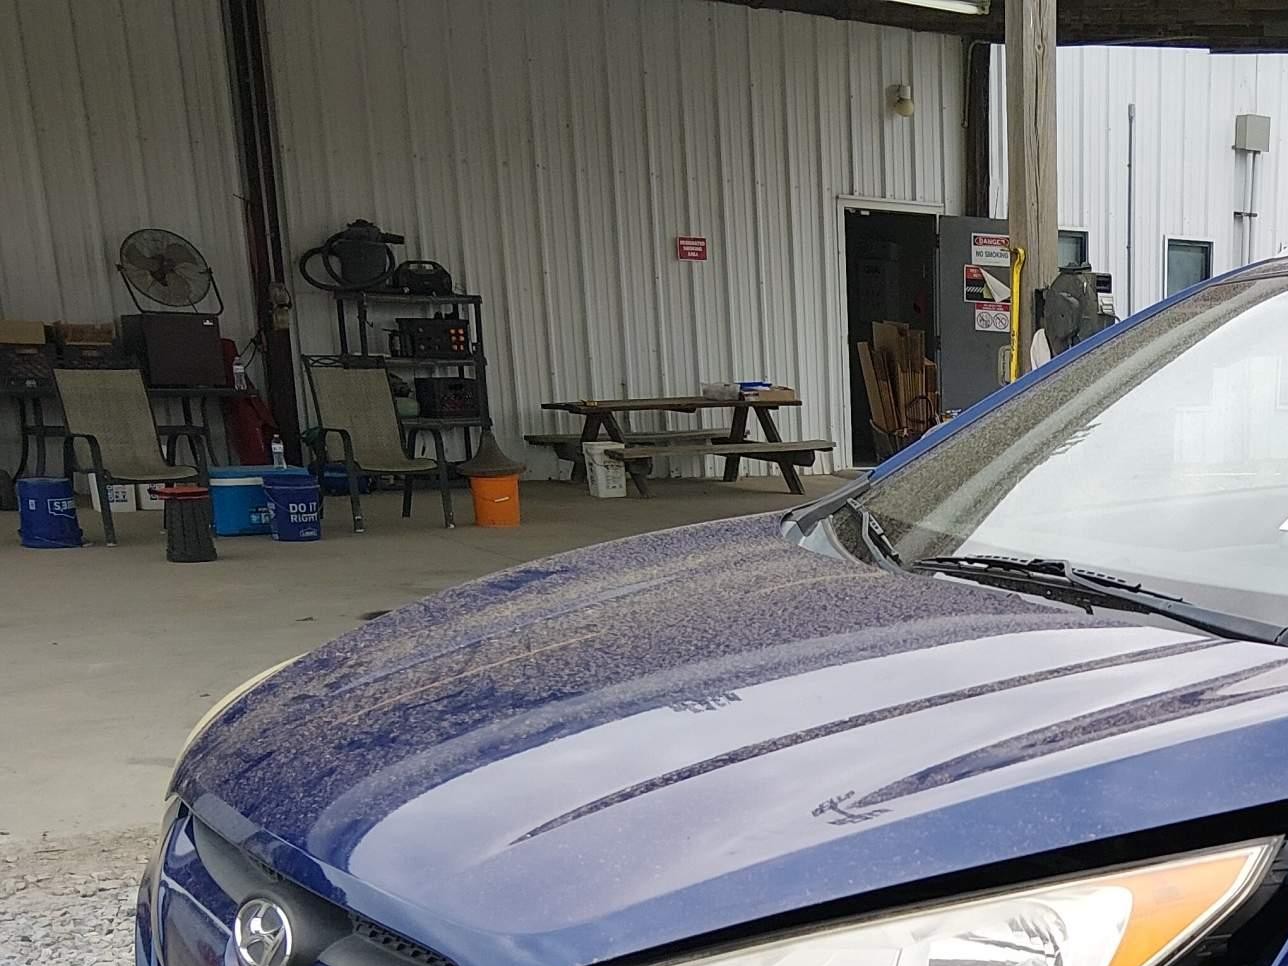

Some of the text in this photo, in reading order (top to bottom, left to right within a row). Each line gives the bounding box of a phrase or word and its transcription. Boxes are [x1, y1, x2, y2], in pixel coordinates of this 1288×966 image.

[985, 251, 1008, 259] SMOKING
[289, 501, 317, 513] DO IT
[290, 512, 318, 523] RIGHT
